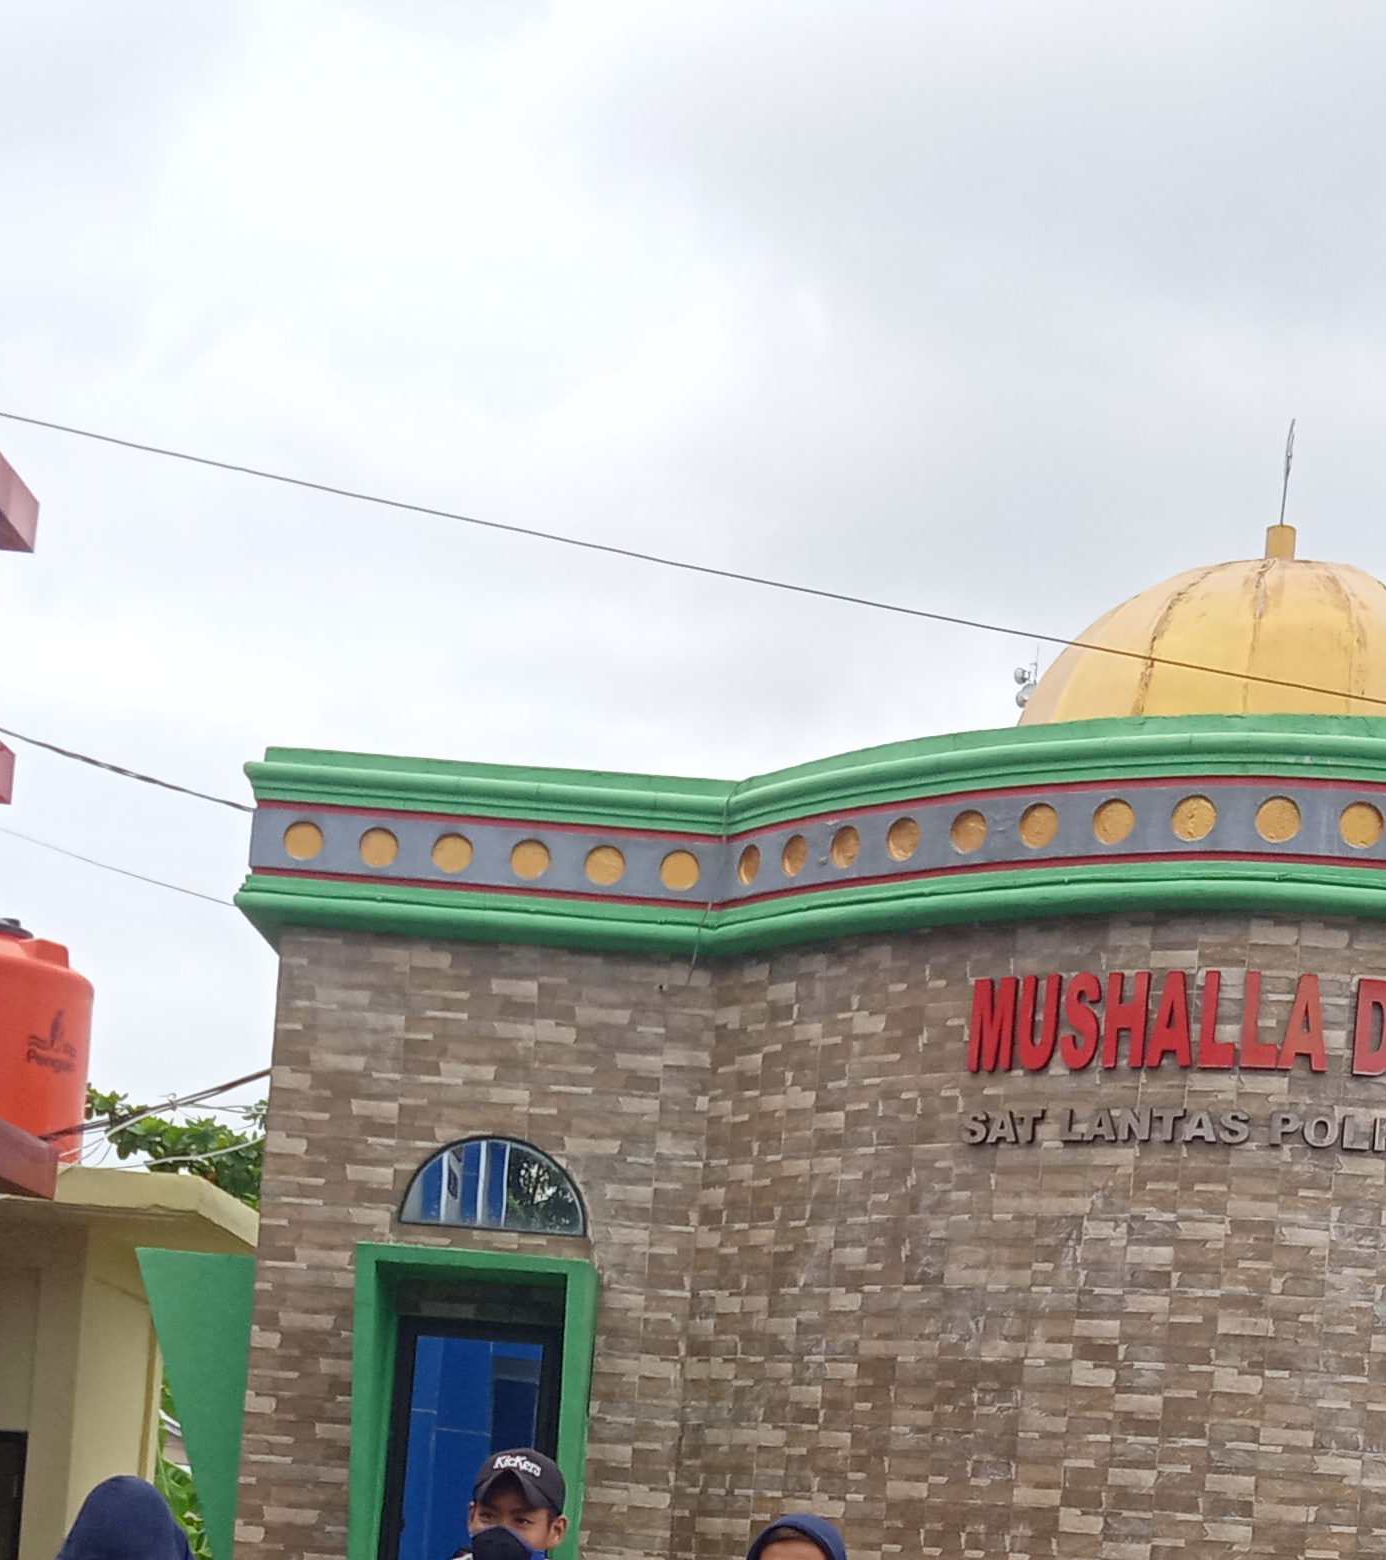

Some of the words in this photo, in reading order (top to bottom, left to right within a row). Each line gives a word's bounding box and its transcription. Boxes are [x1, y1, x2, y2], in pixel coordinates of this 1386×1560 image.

[966, 970, 1328, 1073] MUSHALLA
[963, 1108, 1046, 1146] SAT
[1059, 1106, 1250, 1145] LANTAS
